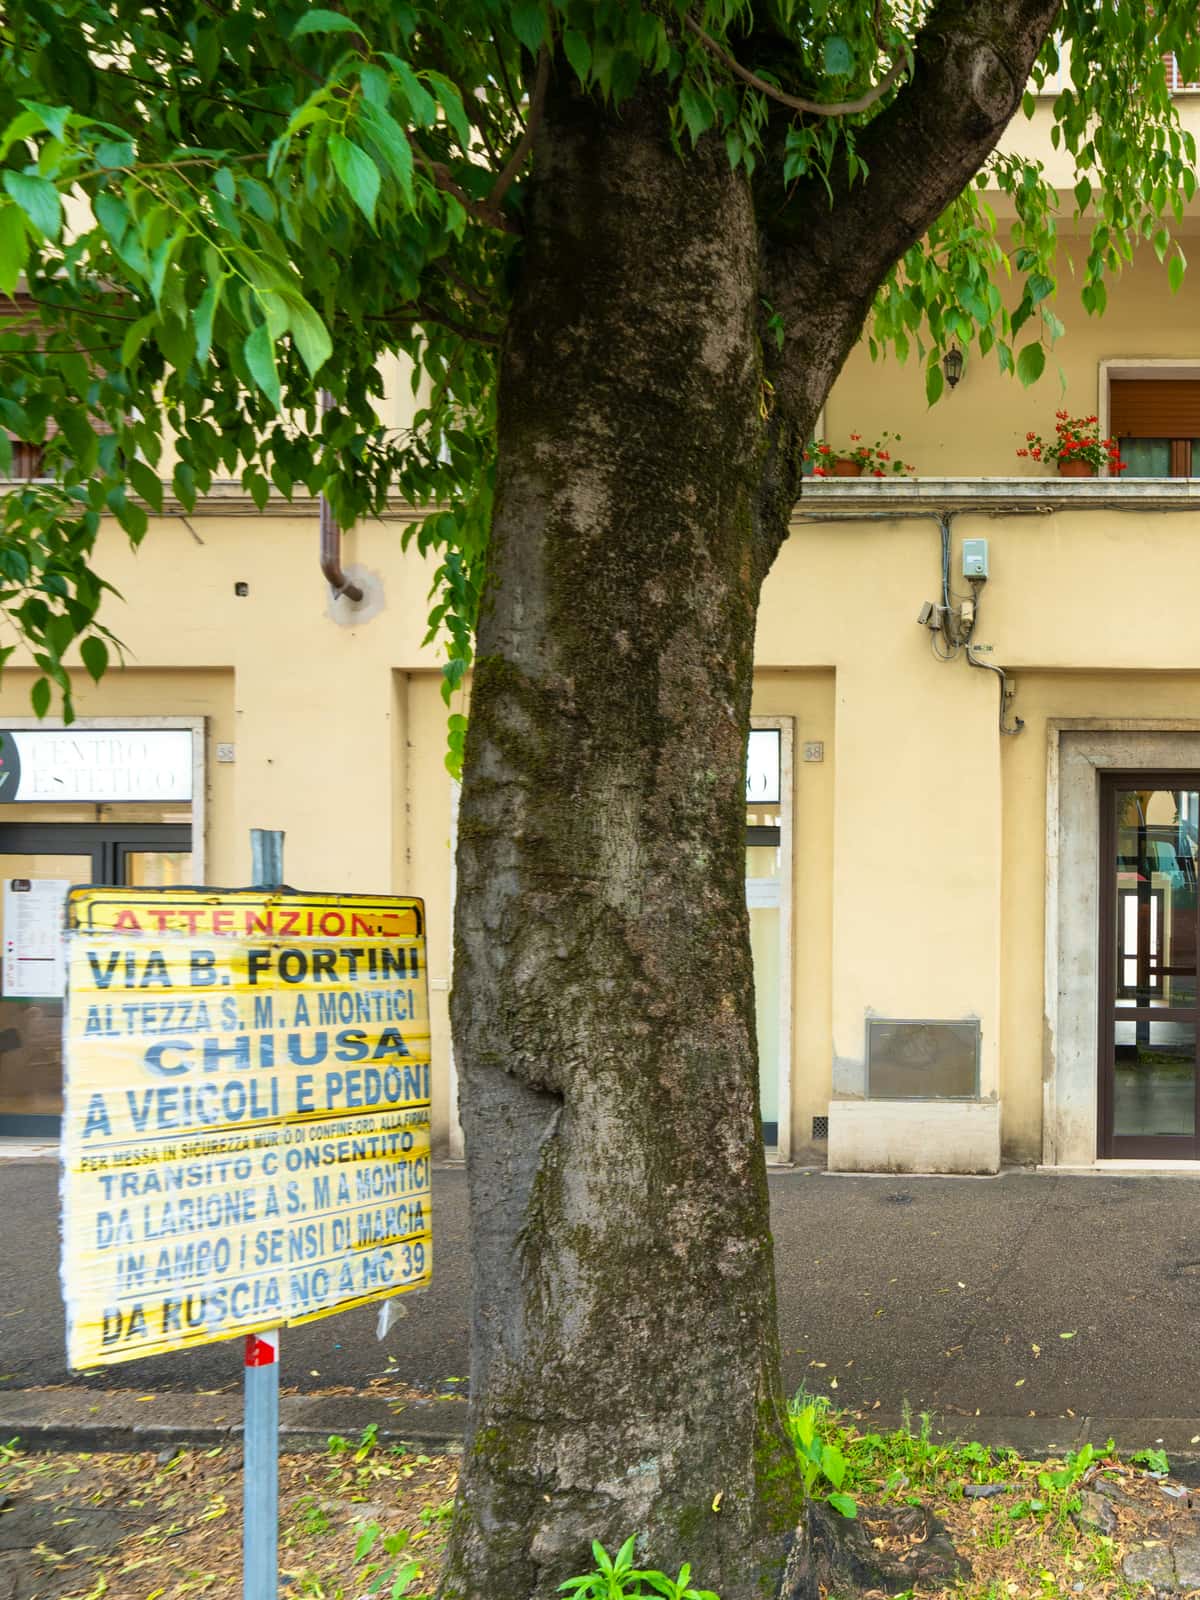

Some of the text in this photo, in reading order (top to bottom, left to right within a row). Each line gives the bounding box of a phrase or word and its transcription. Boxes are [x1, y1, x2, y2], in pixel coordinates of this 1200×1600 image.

[86, 947, 419, 989] VIA B. FORTINI
[85, 1000, 211, 1036] ALTEZZA
[294, 993, 311, 1027] A
[318, 989, 414, 1026] MONTICI
[143, 1028, 410, 1077] CHIUSA
[80, 1063, 430, 1139] A VEICOLI E PEDONI
[80, 1155, 109, 1173] PER
[112, 1147, 159, 1168] MESSA
[163, 1143, 177, 1162] IN
[181, 1135, 251, 1159] SICUREZZA
[295, 1128, 306, 1145] DI
[380, 1114, 402, 1131] ALLA
[404, 1110, 430, 1127] FIRMA
[96, 1208, 134, 1250] DA
[144, 1189, 257, 1240] LARIONE
[265, 1185, 280, 1217] A
[337, 1172, 352, 1206] A
[356, 1156, 430, 1202] MONTICI
[98, 1157, 253, 1200] TRANSITO
[116, 1252, 146, 1292] IN
[154, 1236, 231, 1285] AMBO
[255, 1222, 326, 1267] SENSI
[332, 1216, 352, 1252] DI
[357, 1200, 426, 1248] MARCIA
[102, 1302, 149, 1346] DA
[401, 1241, 426, 1278] 39
